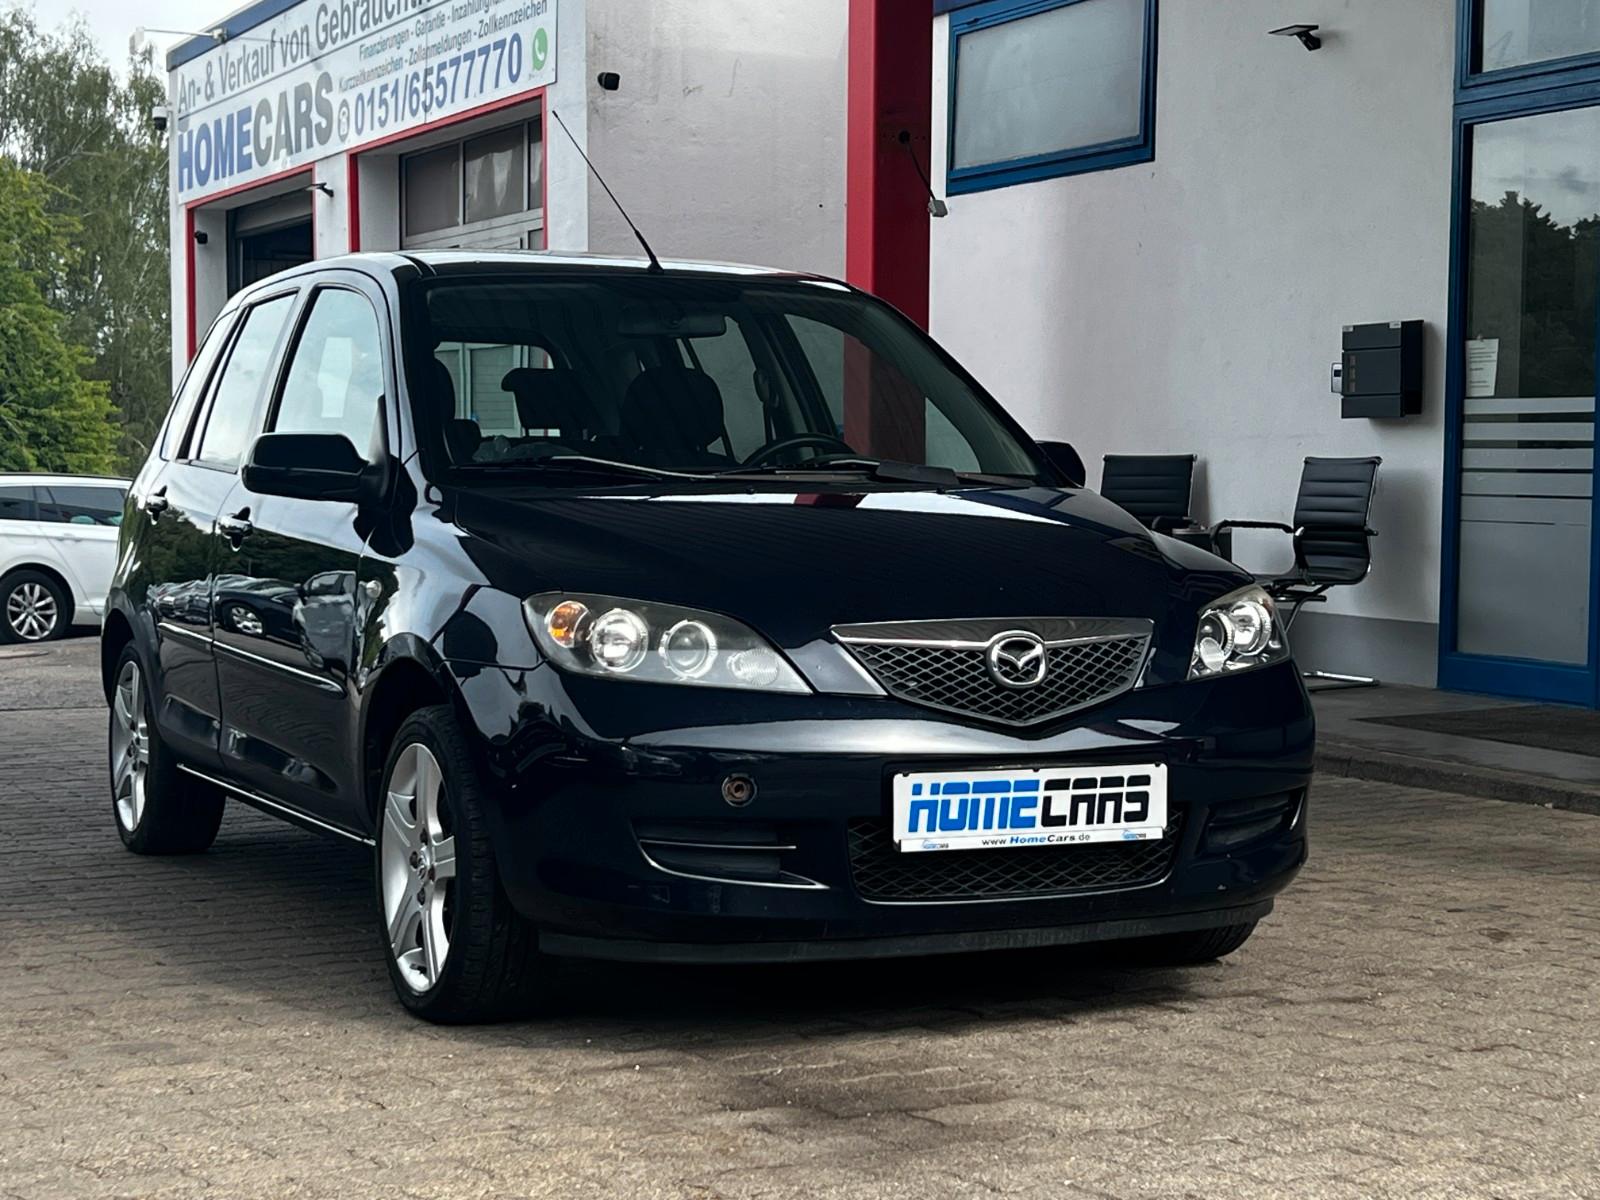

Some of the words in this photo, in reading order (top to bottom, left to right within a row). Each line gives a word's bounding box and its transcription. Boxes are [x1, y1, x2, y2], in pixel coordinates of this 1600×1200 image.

[478, 0, 548, 39] Zollkennzeichen
[178, 73, 201, 113] An-
[204, 60, 215, 102] &
[218, 28, 276, 95] Verkauf
[280, 24, 309, 68] von
[354, 32, 522, 136] 0151/65577770
[177, 71, 334, 193] HOMECARS
